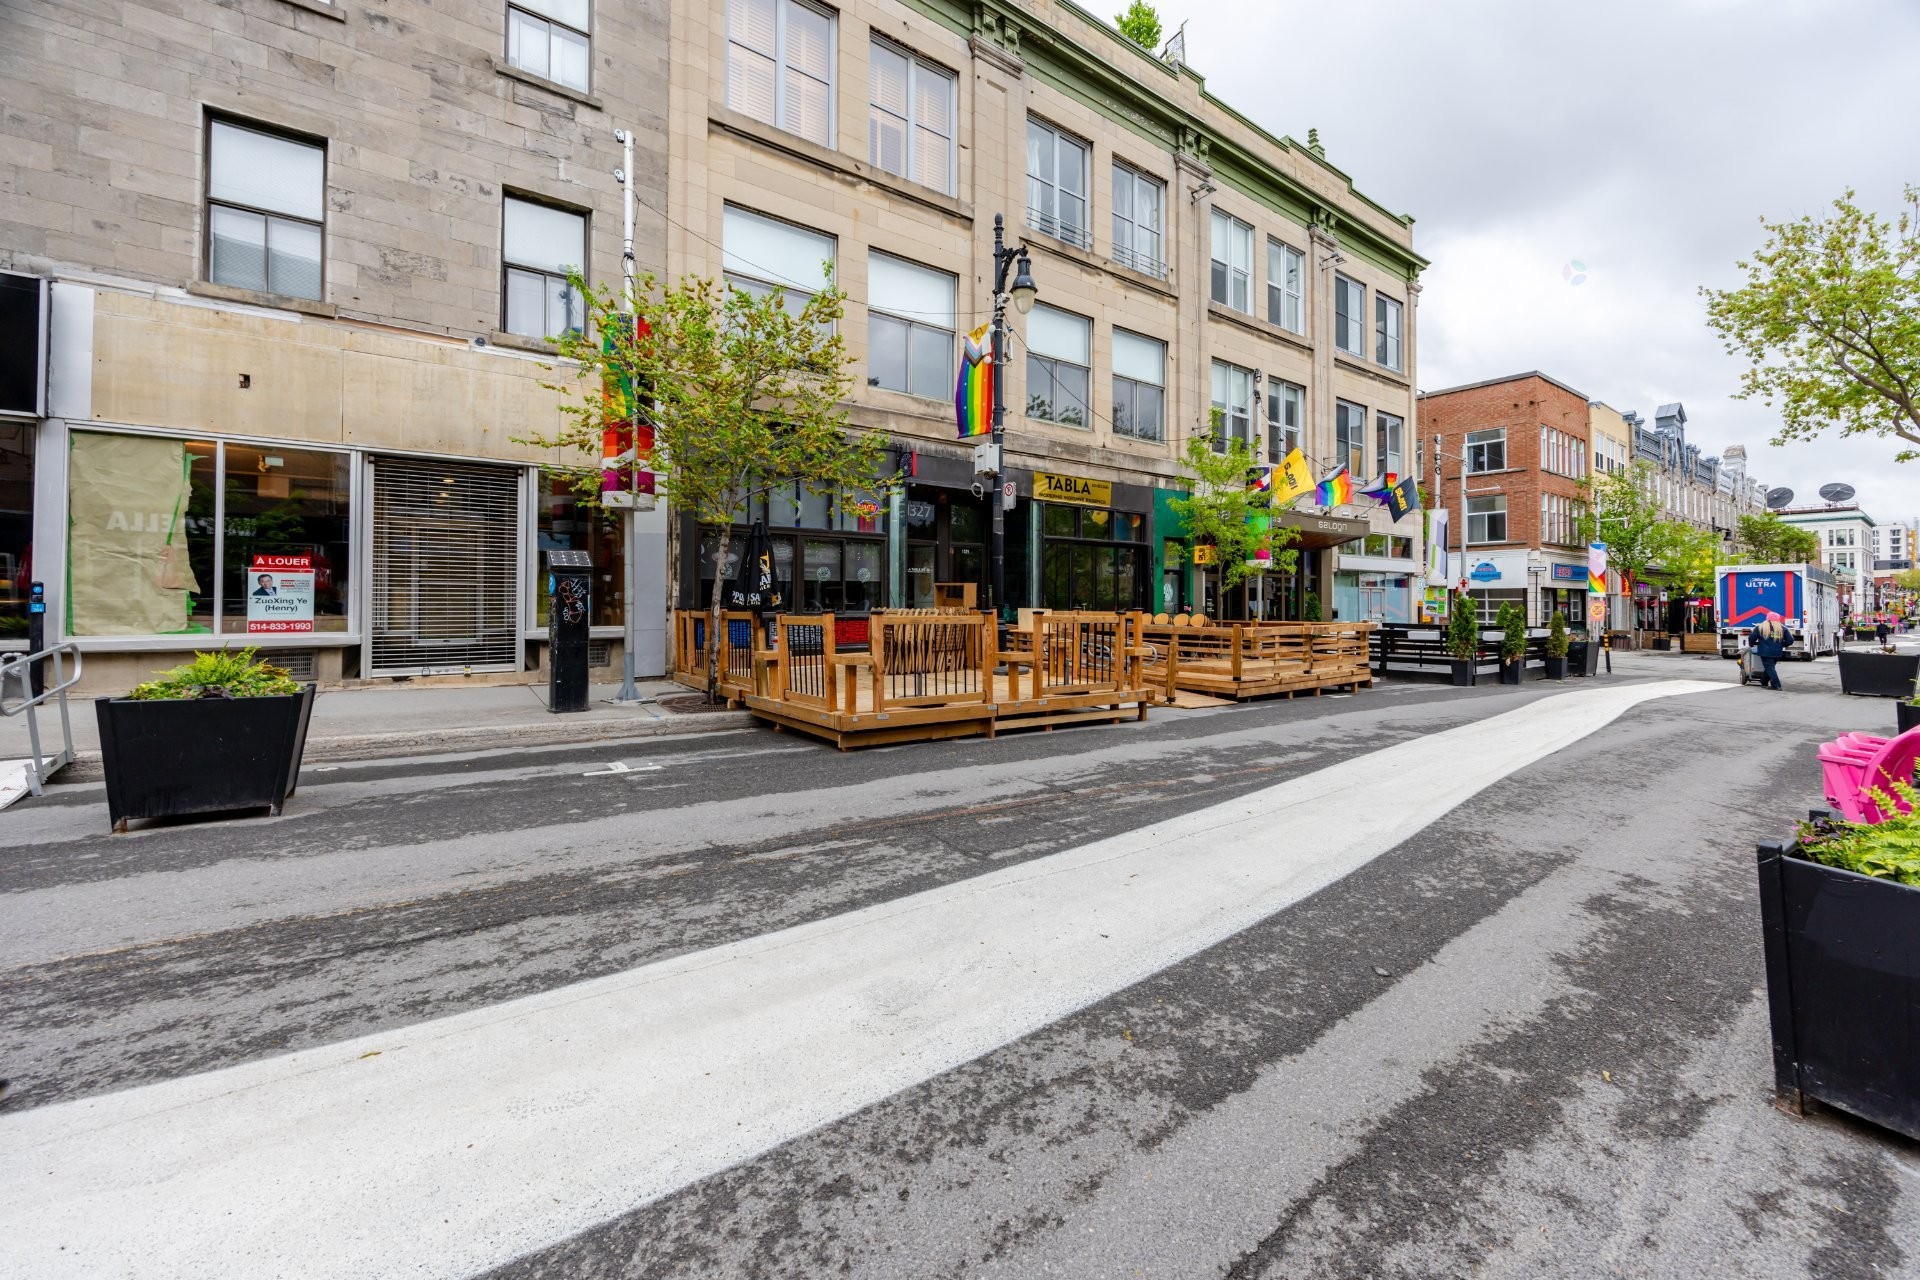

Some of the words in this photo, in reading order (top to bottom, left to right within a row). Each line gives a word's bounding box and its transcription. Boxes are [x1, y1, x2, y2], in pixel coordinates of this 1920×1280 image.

[1045, 475, 1091, 495] TABLA
[268, 557, 309, 566] LOUER
[255, 597, 294, 605] ZuoXing
[250, 622, 311, 630] 514-833-1993
